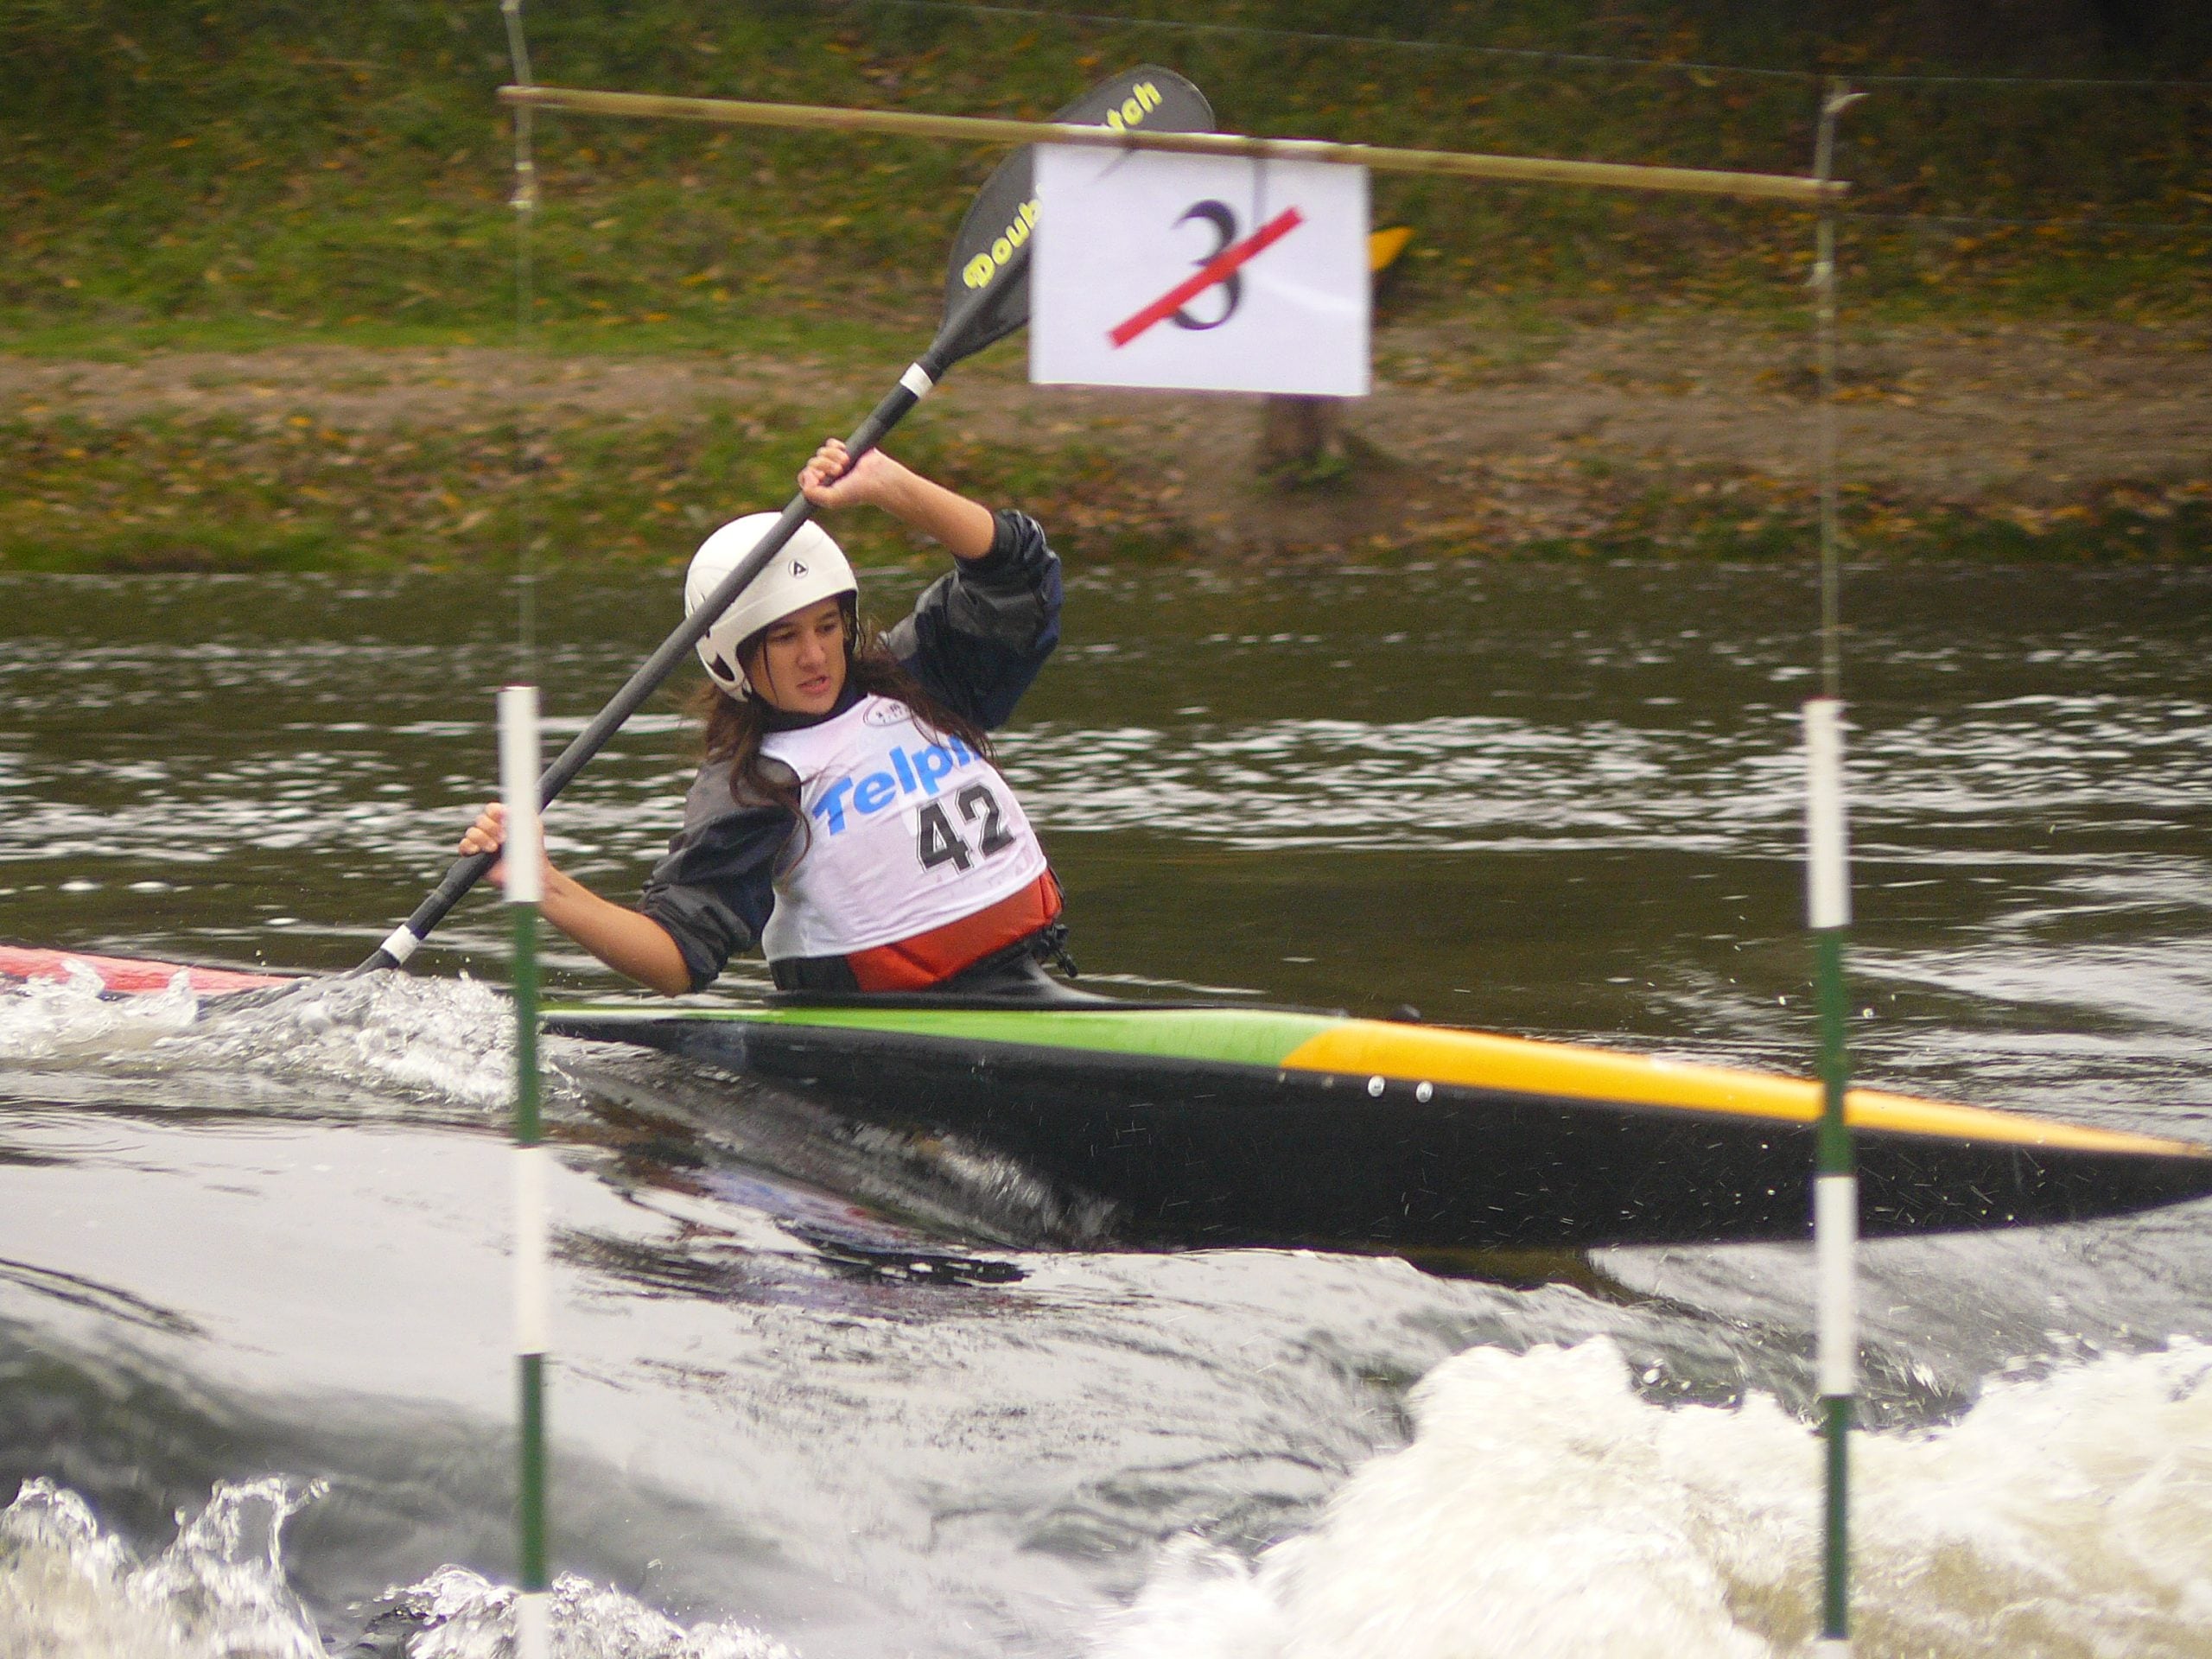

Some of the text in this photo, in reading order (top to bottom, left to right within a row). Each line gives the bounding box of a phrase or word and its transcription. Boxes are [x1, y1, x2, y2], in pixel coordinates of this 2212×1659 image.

[963, 182, 1045, 289] Doub
[1171, 199, 1243, 331] 3
[916, 780, 1016, 875] 42
